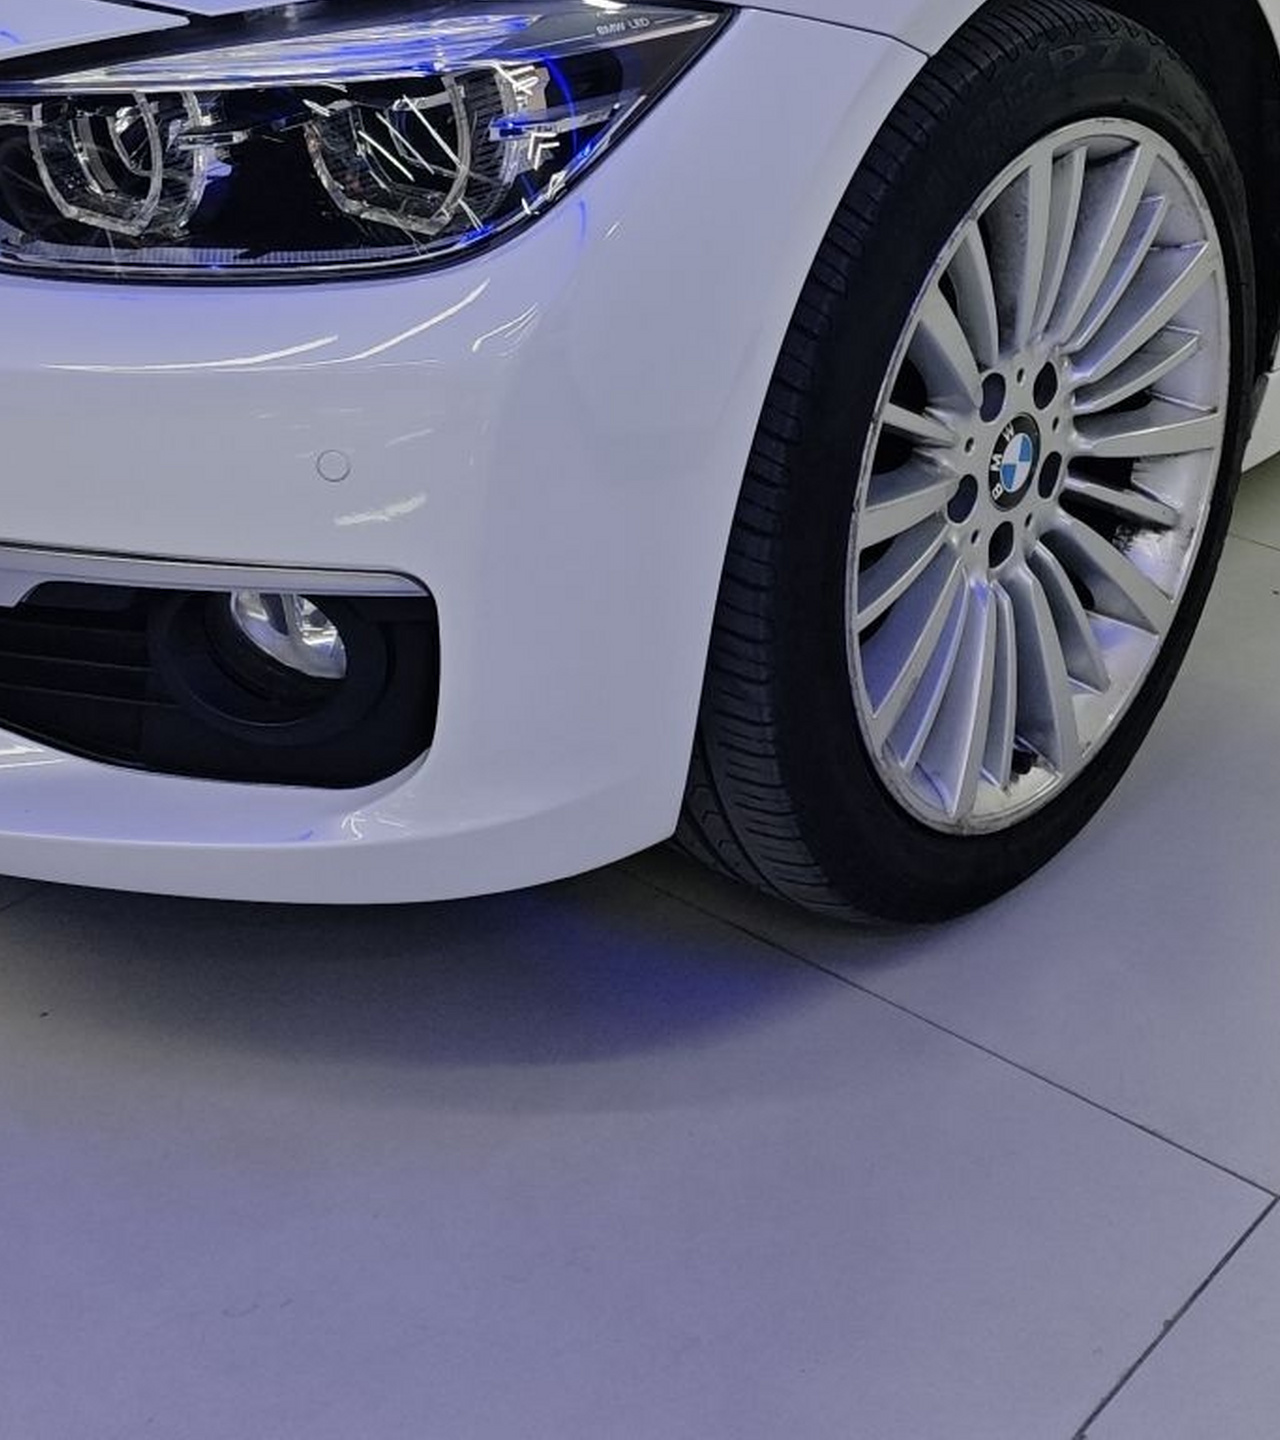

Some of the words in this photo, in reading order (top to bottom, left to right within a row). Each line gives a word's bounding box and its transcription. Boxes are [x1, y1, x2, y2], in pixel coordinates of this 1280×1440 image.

[596, 22, 626, 36] BMW
[627, 17, 650, 29] LED
[990, 422, 1015, 501] BMW
